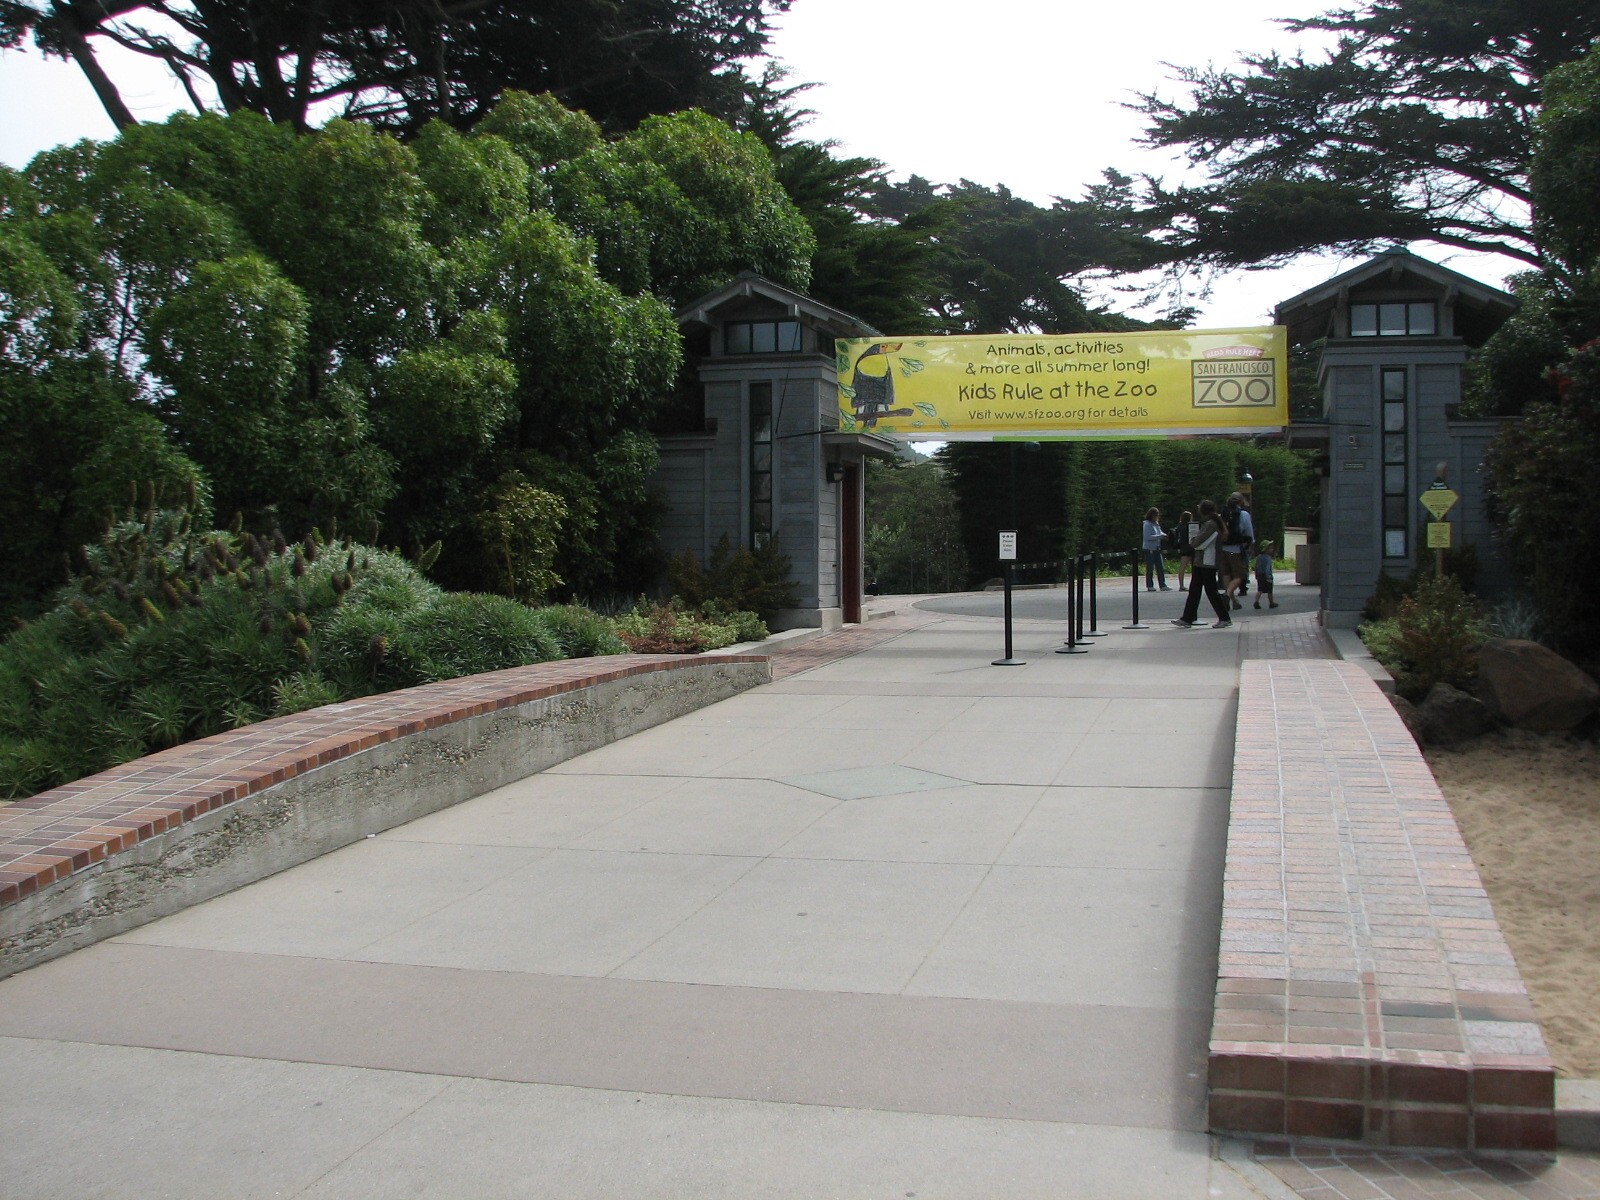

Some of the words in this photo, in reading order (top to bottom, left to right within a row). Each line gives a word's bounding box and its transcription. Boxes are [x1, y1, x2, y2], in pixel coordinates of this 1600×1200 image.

[986, 343, 1050, 357] Animals,
[1054, 341, 1124, 355] activities
[965, 362, 976, 375] &
[980, 362, 1021, 374] more
[1024, 360, 1042, 374] all
[1046, 360, 1108, 373] summer
[1112, 359, 1150, 374] long!
[1197, 363, 1216, 374] SAN
[1217, 362, 1269, 374] FRANCISCO
[958, 383, 997, 402] Kids
[1002, 382, 1044, 401] Rule
[1049, 381, 1071, 400] at
[1075, 380, 1109, 399] the
[1114, 380, 1158, 397] Zoo
[1197, 378, 1270, 404] ZOO
[968, 410, 992, 420] Visit
[994, 408, 1085, 420] www.sfzoo.org
[1088, 407, 1106, 418] for
[1108, 406, 1149, 418] details
